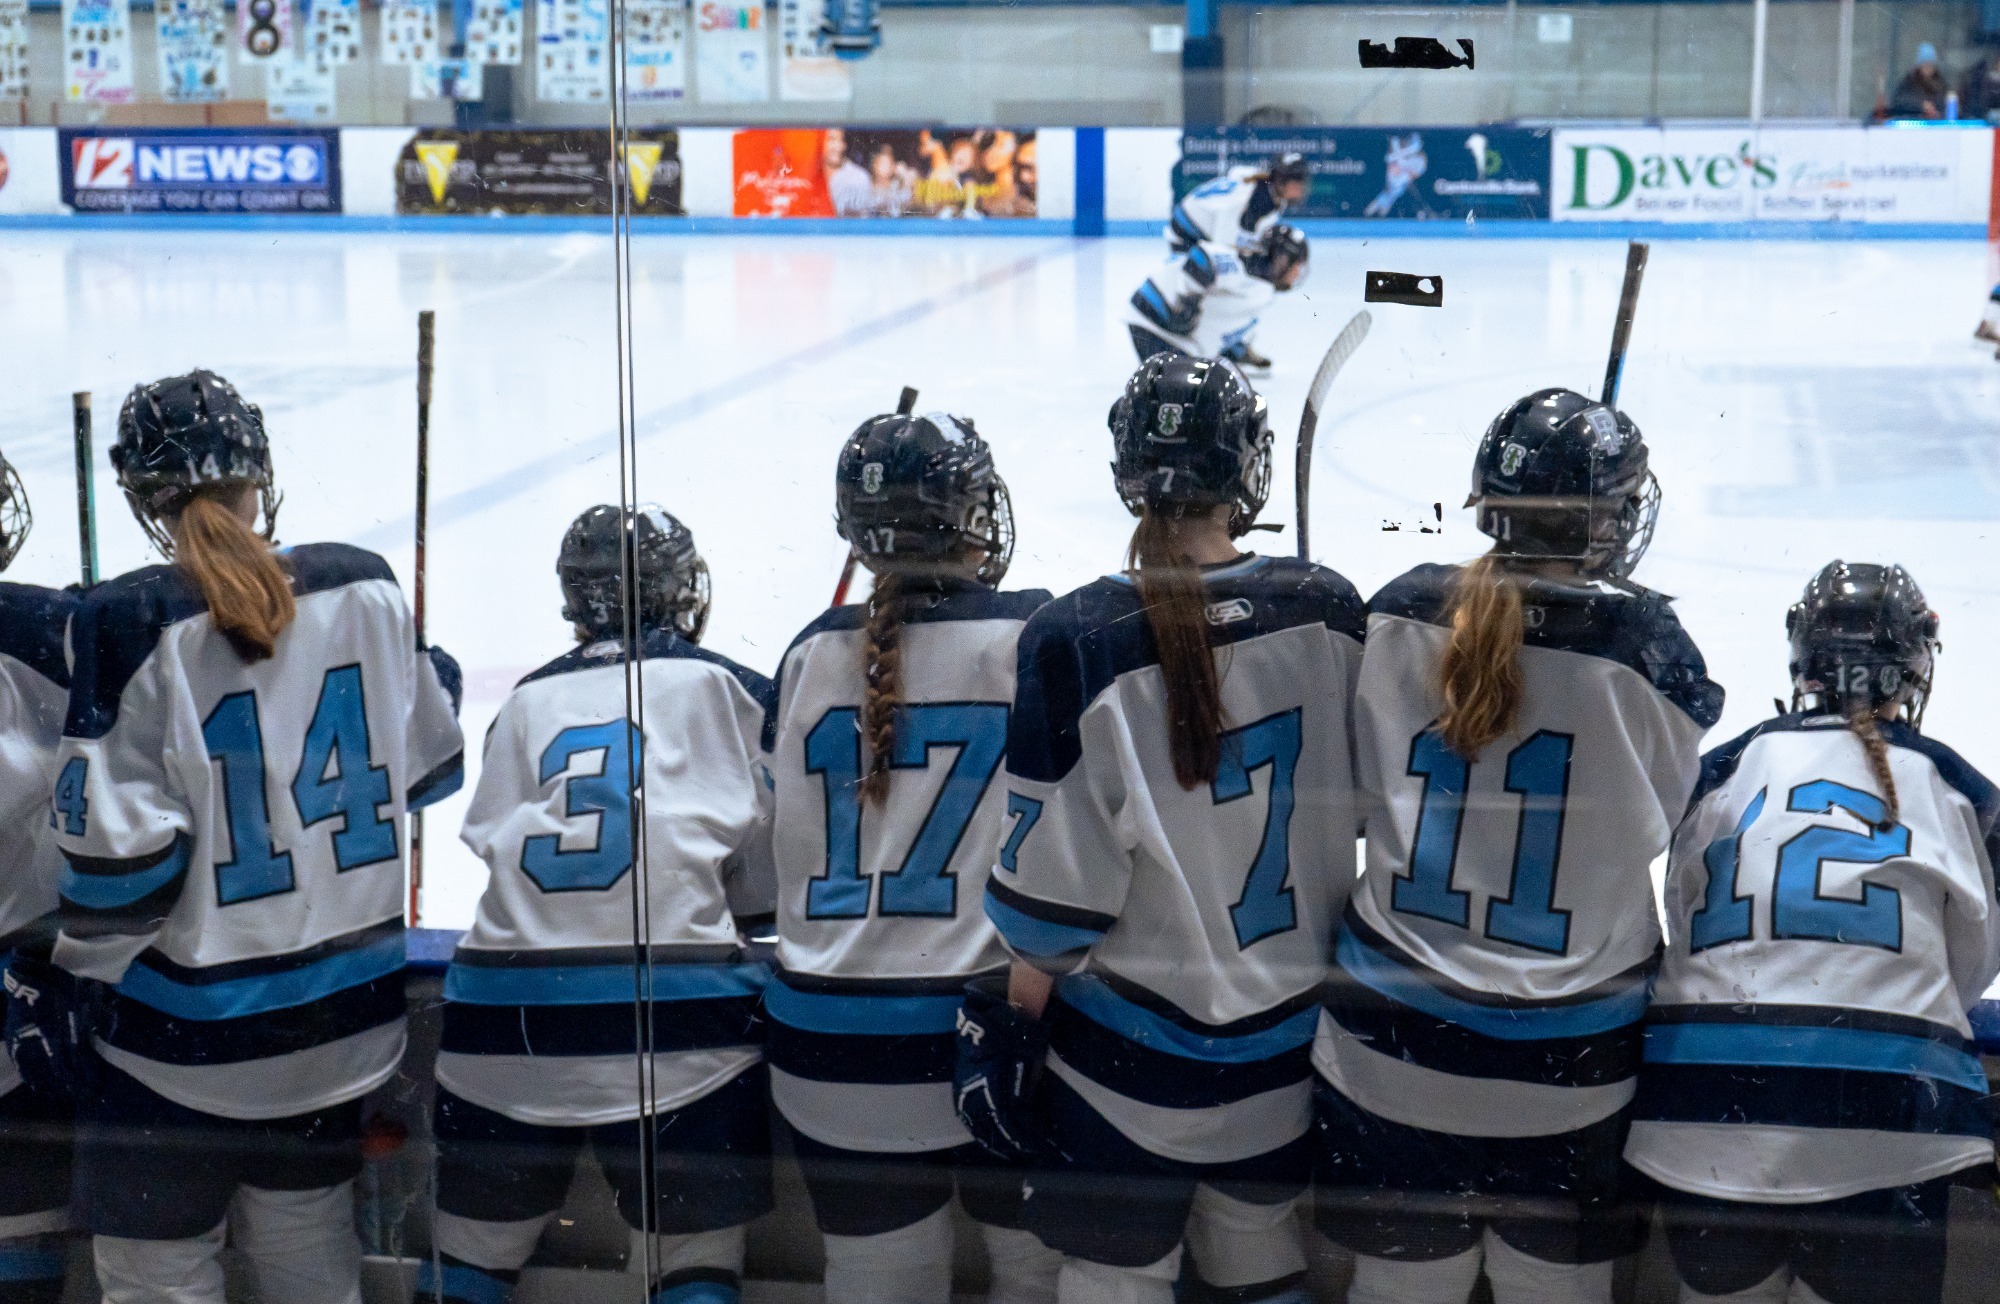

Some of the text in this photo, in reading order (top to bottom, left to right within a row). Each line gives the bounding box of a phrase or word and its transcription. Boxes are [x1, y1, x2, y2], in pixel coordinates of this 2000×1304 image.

[74, 138, 283, 187] 12 NEWS
[1567, 139, 1778, 211] Dave's
[185, 453, 222, 485] 14
[1158, 467, 1176, 494] 7
[865, 527, 896, 554] 17
[1491, 511, 1513, 542] 11
[1835, 665, 1869, 694] 12
[48, 756, 89, 836] 4
[202, 662, 398, 907] 14
[520, 717, 645, 894] 3
[806, 702, 1012, 919] 17
[1000, 791, 1043, 874] 7
[1208, 705, 1303, 951] 7
[1391, 720, 1575, 956] 11
[1691, 778, 1912, 955] 12
